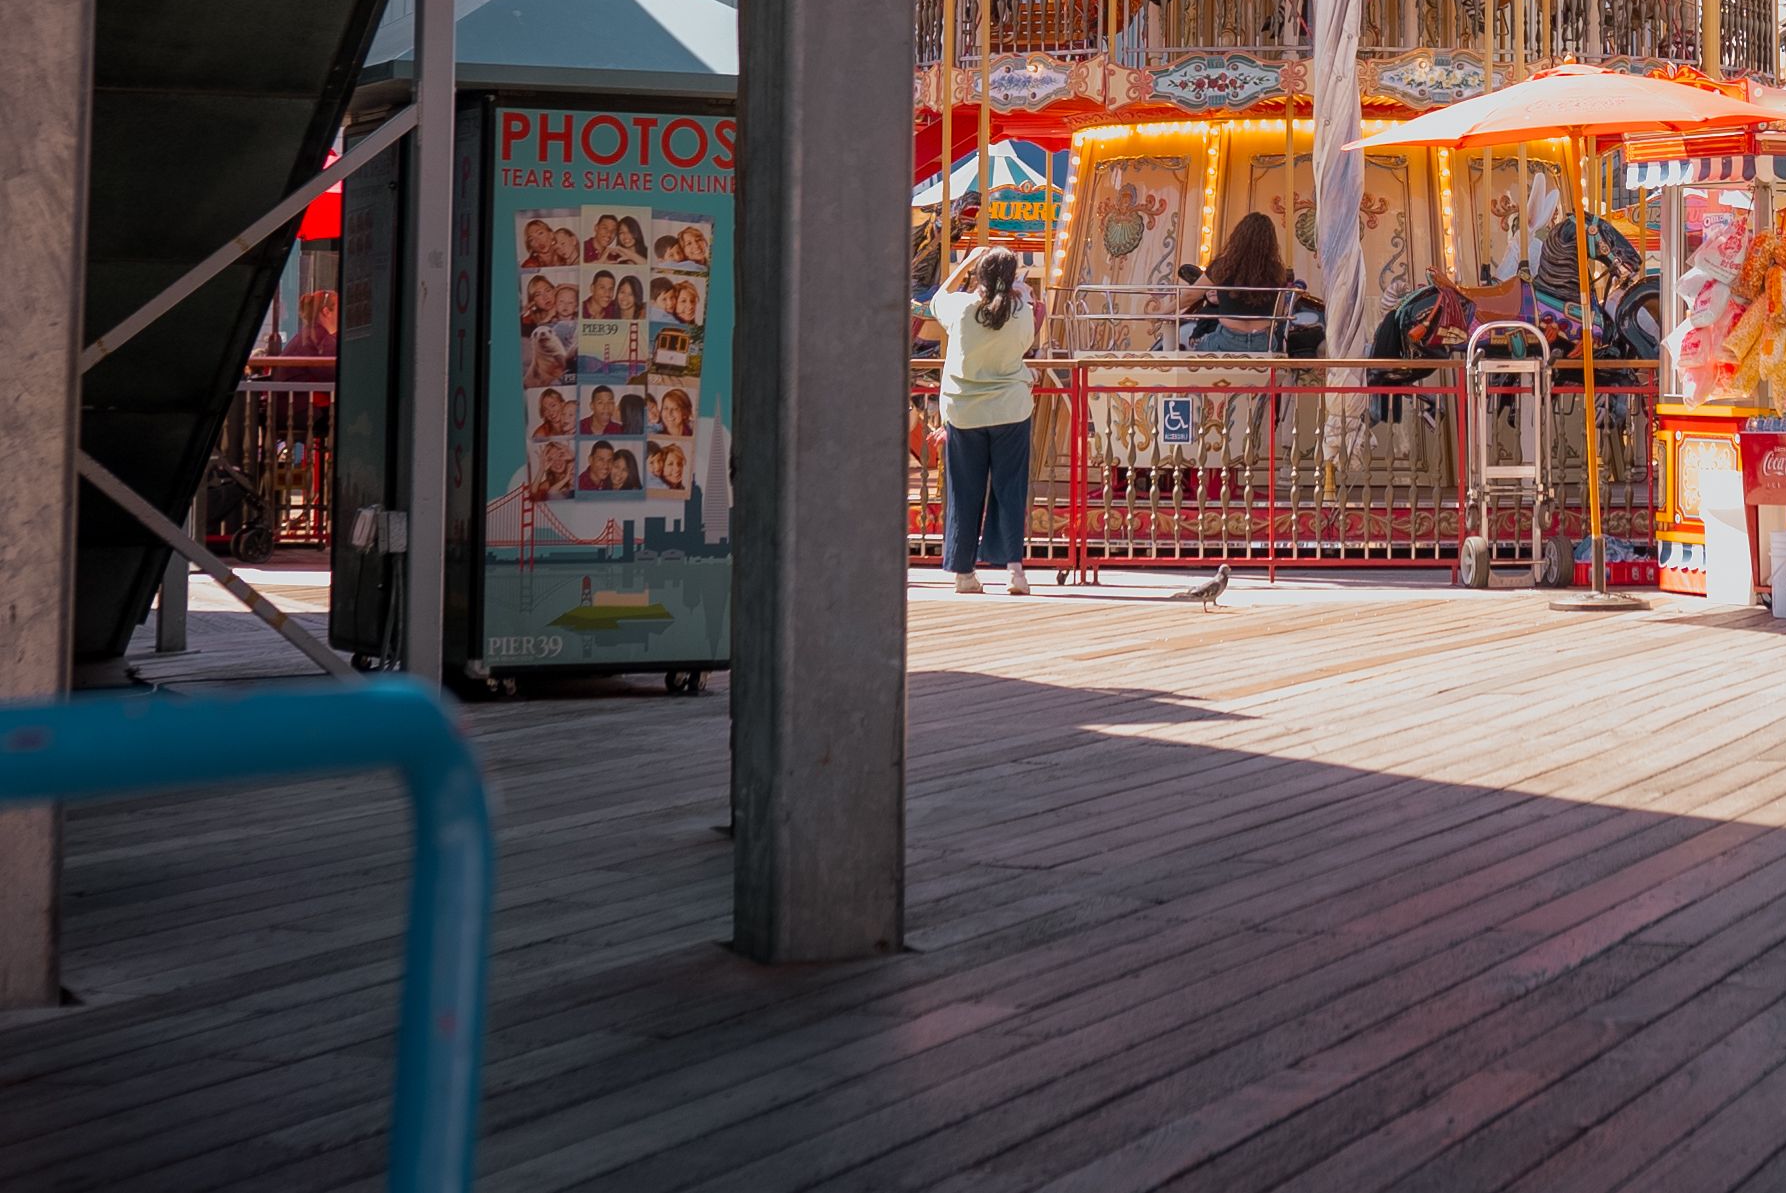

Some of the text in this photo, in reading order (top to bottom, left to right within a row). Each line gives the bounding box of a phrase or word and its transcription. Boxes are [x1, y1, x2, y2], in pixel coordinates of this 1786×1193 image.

[501, 111, 736, 170] PHOTOS
[502, 168, 553, 188] TEAR
[561, 171, 576, 189] &
[583, 171, 653, 192] SHARE
